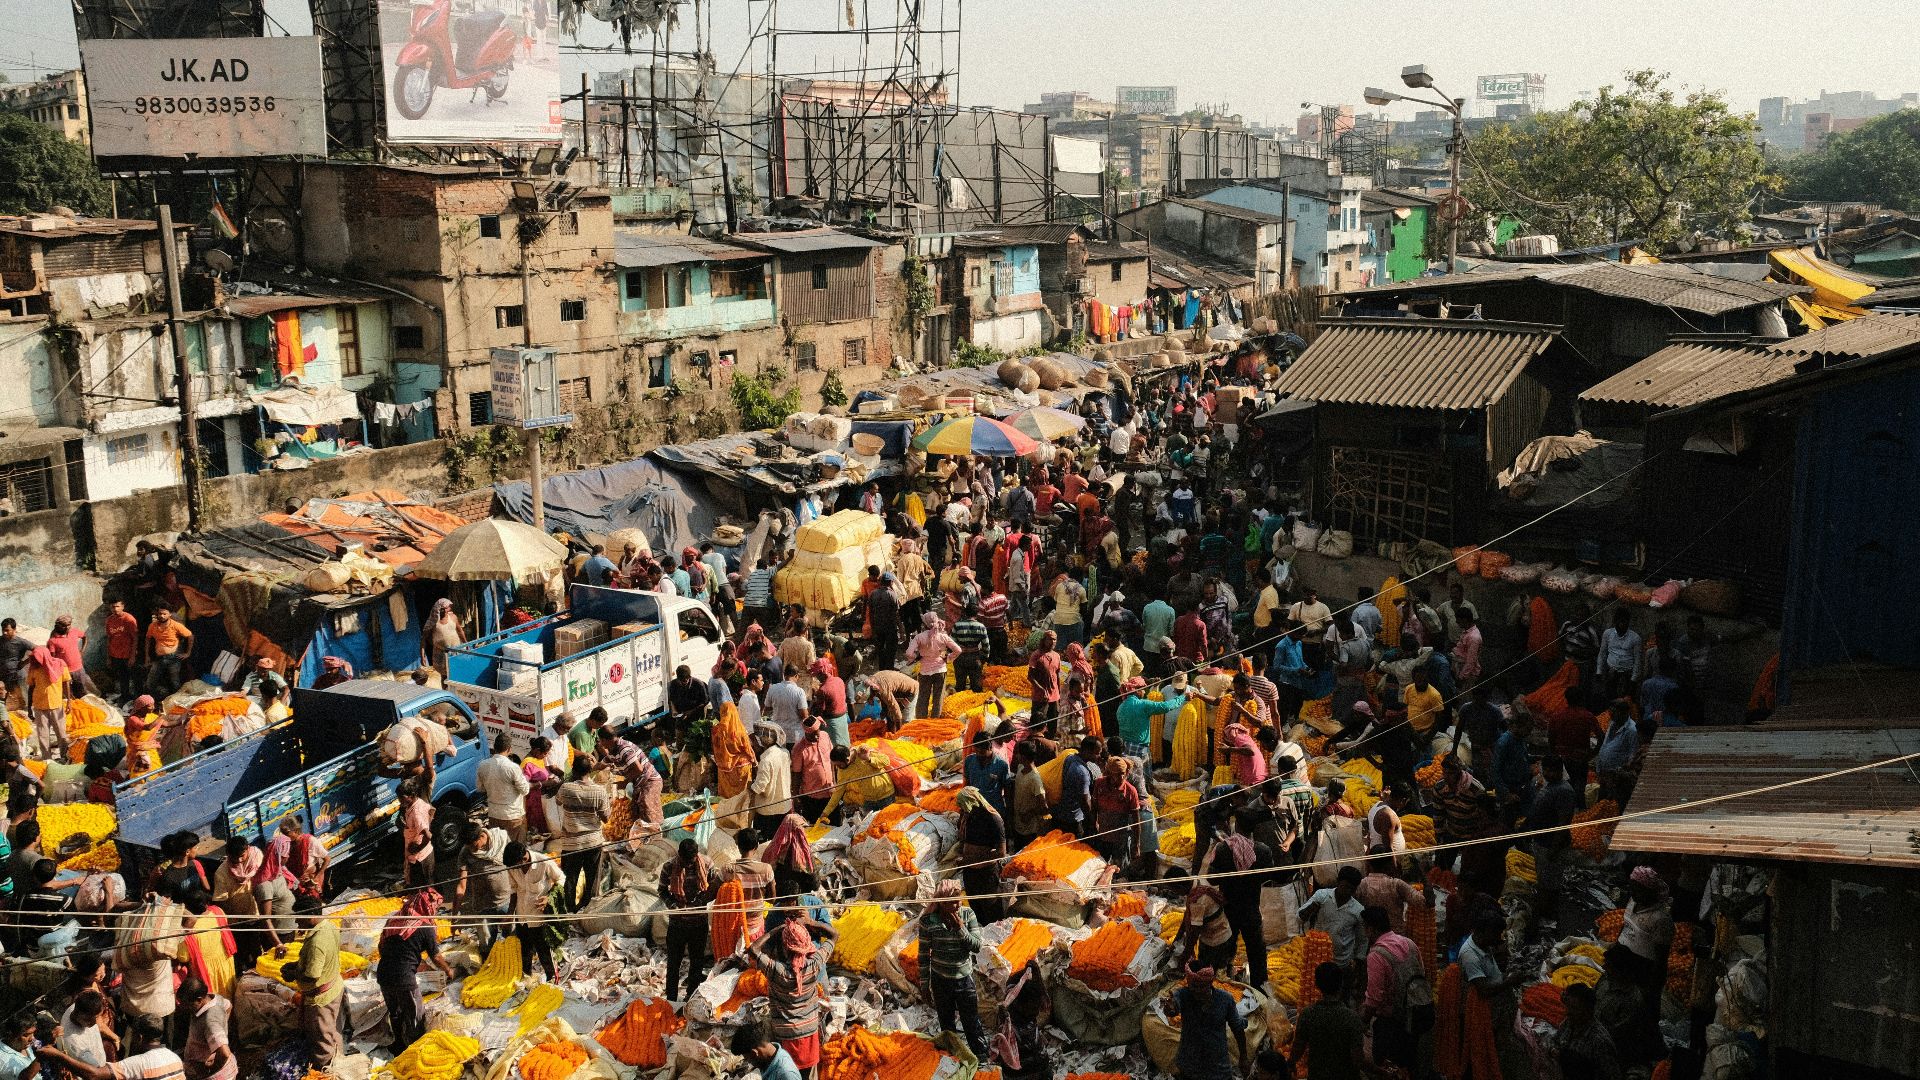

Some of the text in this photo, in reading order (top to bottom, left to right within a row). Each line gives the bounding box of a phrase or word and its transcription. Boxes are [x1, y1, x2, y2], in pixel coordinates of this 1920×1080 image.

[161, 58, 249, 82] J.K. AD
[135, 96, 275, 114] 9830039536
